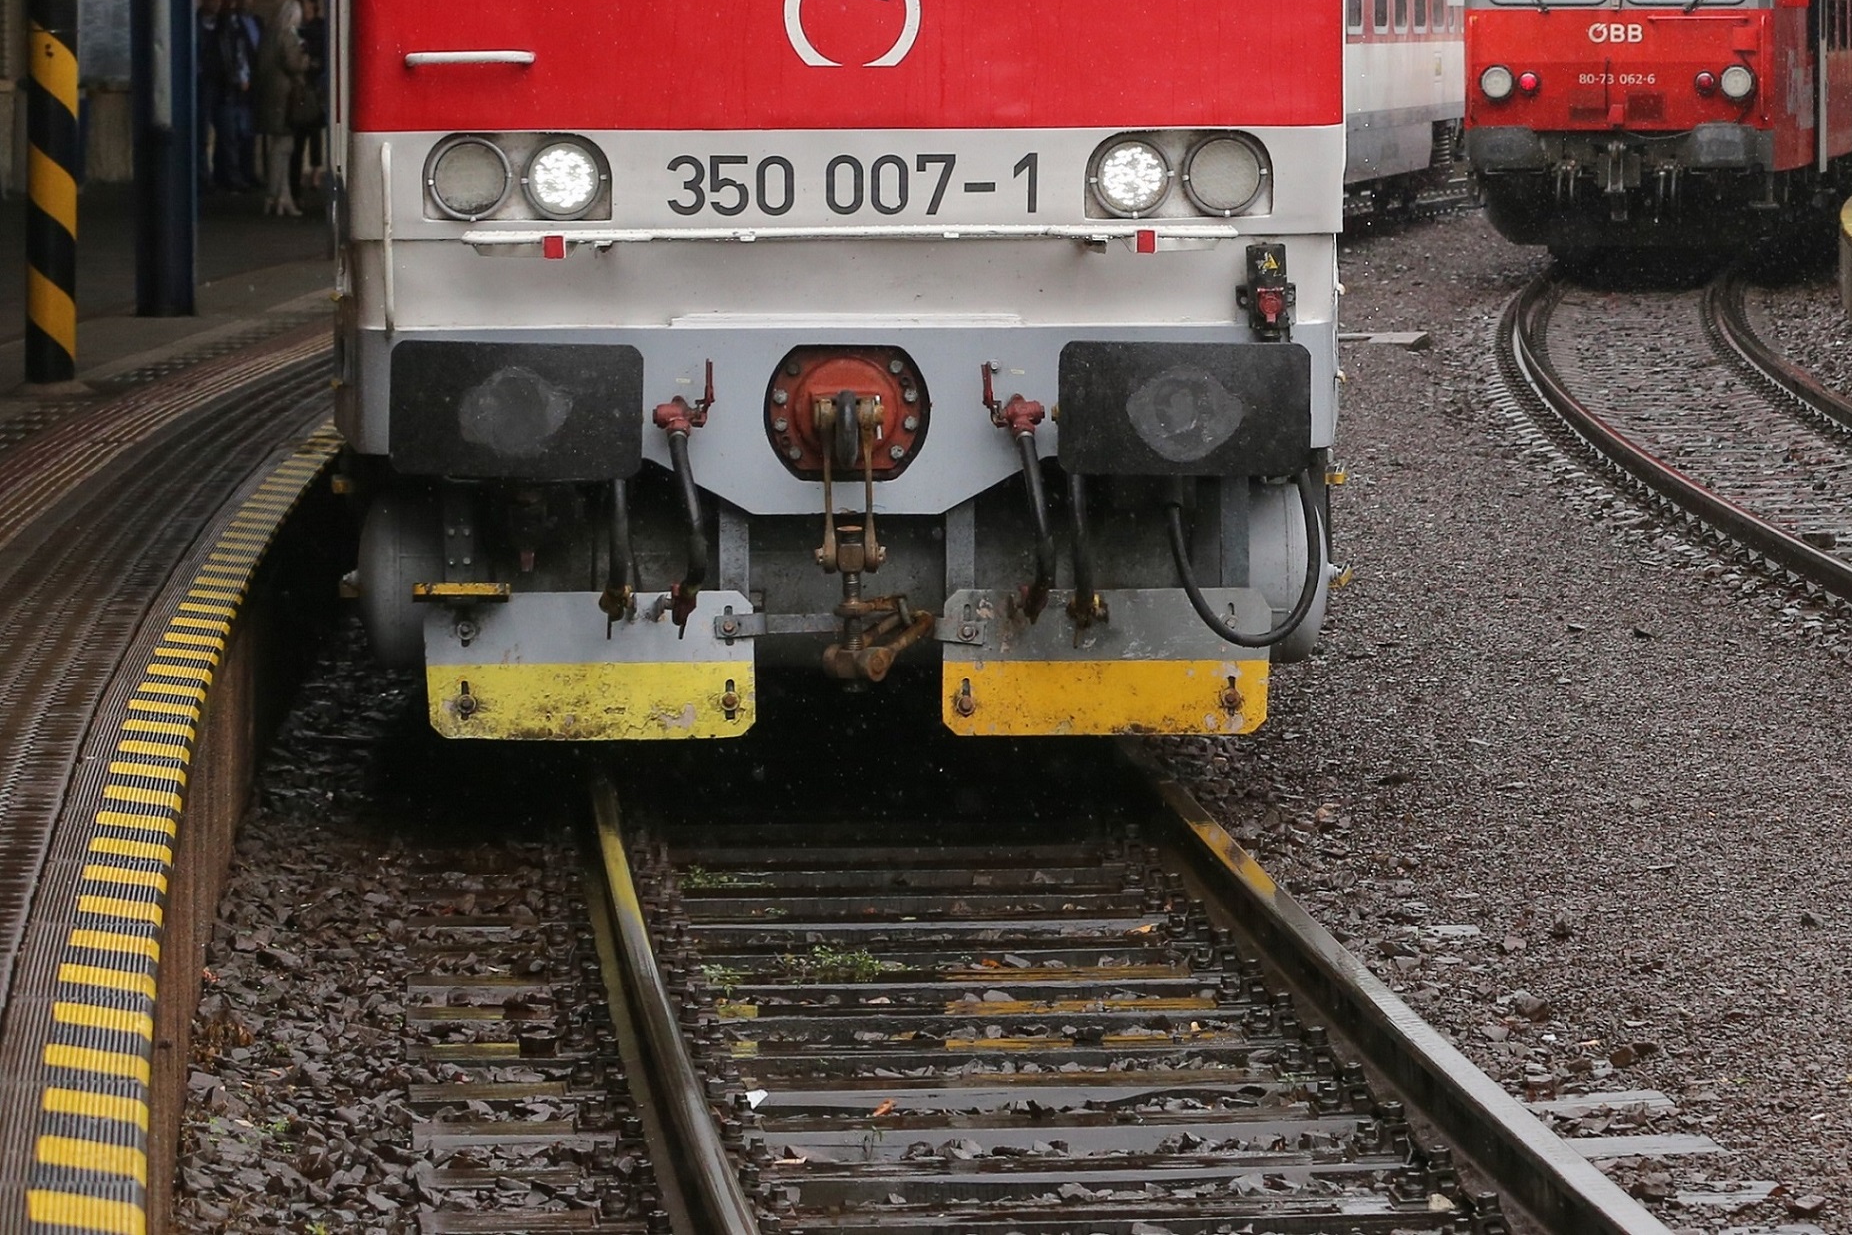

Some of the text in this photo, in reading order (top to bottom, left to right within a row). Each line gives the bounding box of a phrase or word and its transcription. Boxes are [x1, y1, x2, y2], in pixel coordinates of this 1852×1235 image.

[1578, 73, 1656, 85] 80-73 062-6
[666, 152, 1038, 216] 350 007-1
